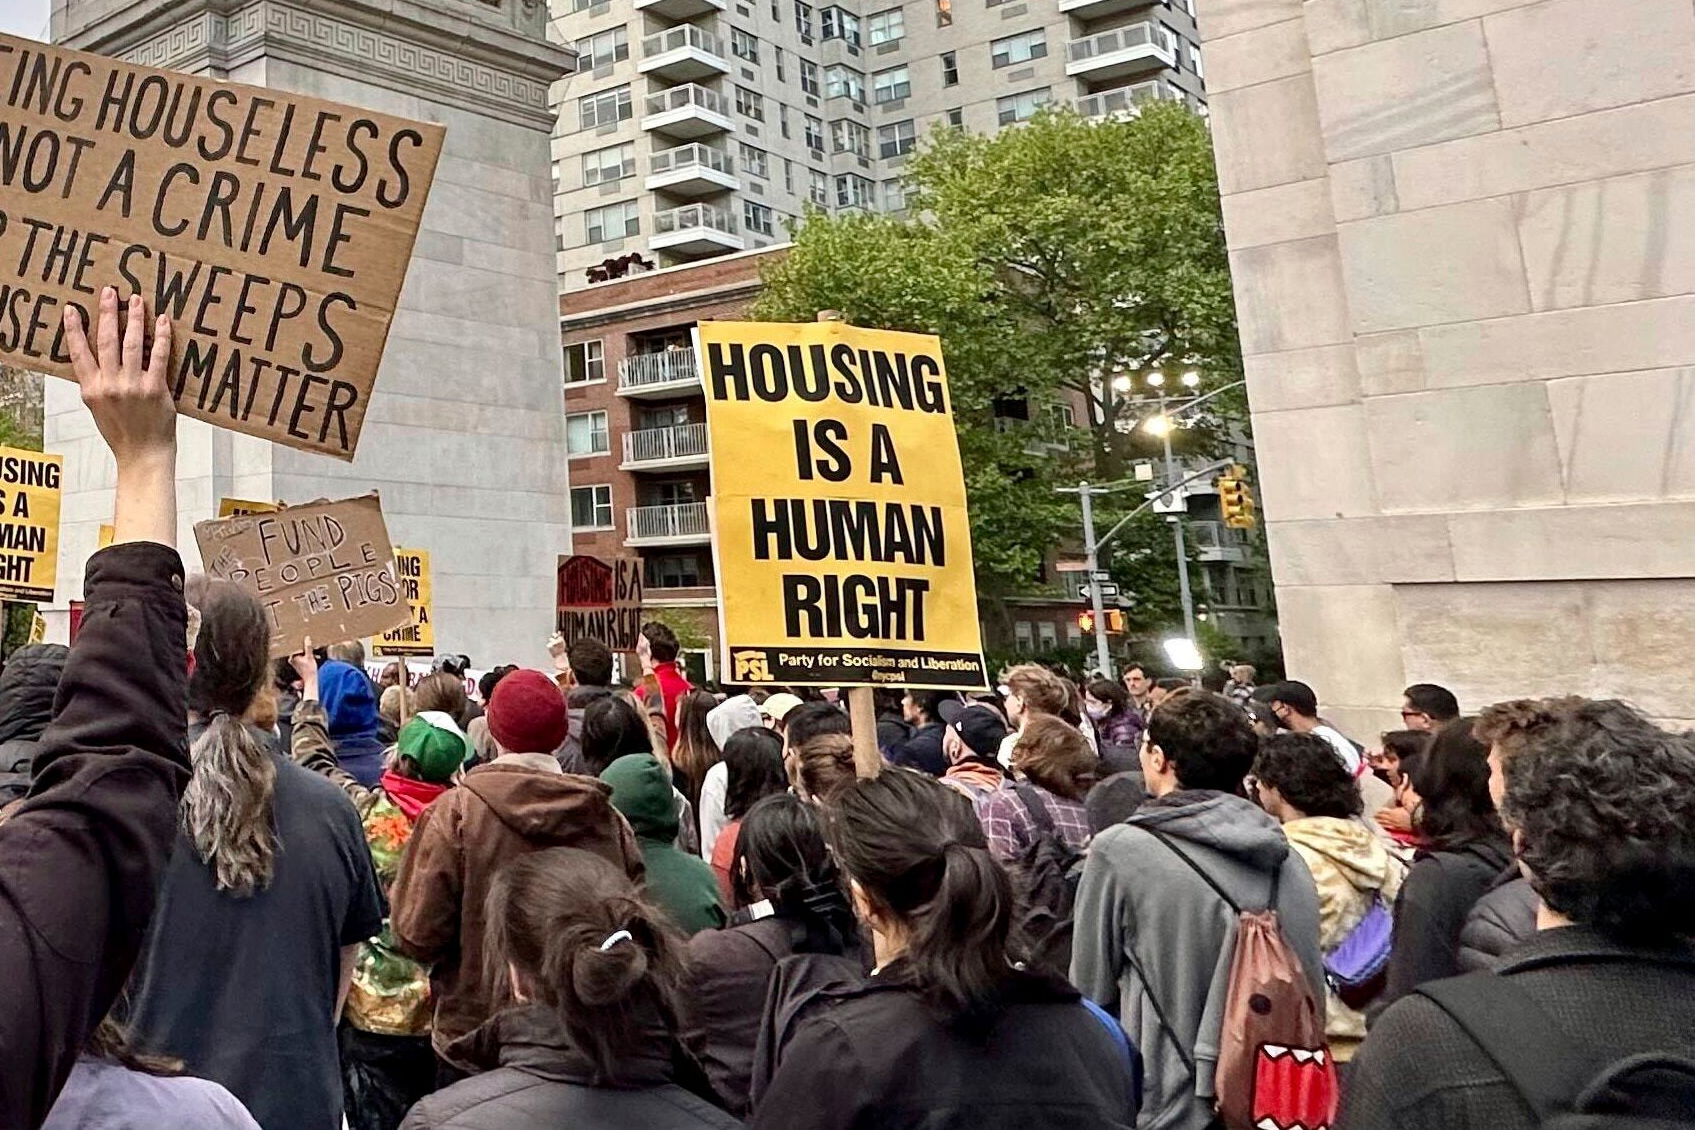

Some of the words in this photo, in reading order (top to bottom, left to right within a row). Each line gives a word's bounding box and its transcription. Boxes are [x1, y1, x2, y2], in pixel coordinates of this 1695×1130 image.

[95, 69, 423, 209] HOUSELESS
[96, 149, 136, 218] A
[152, 162, 371, 278] CRIME
[17, 218, 110, 294] THE
[117, 243, 358, 373] SWEEPS
[173, 338, 359, 451] MATTER
[707, 342, 947, 414] HOUSING
[792, 419, 852, 482] IS
[870, 423, 904, 485] A
[12, 491, 29, 518] A
[258, 515, 345, 565] FUND
[751, 498, 946, 567] HUMAN
[209, 547, 236, 578] THE
[229, 542, 377, 592] PEOPLE
[397, 556, 421, 578] ING
[614, 560, 627, 601] IS
[628, 561, 642, 602] A
[419, 607, 429, 623] A
[558, 610, 606, 649] HUMAN
[606, 607, 642, 649] RIGHT
[782, 574, 930, 641] RIGHT
[736, 658, 775, 681] PSL
[778, 653, 814, 669] Party
[818, 653, 839, 667] for
[842, 653, 896, 668] Socialism
[897, 656, 919, 669] and
[920, 656, 980, 671] Liberation
